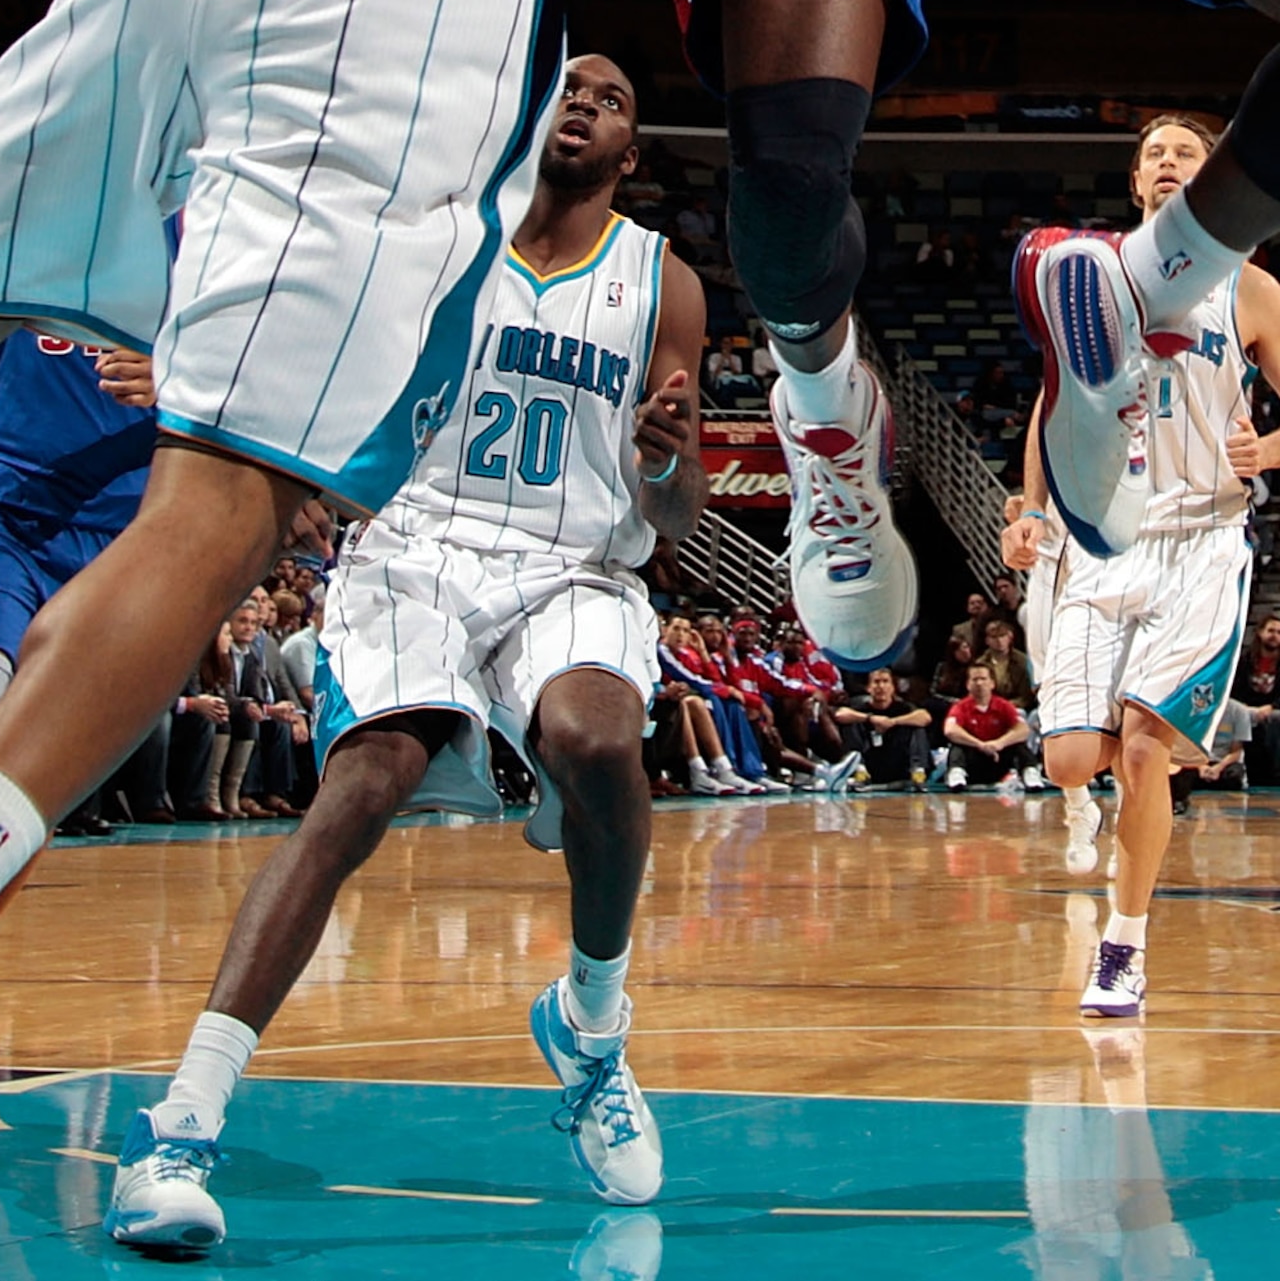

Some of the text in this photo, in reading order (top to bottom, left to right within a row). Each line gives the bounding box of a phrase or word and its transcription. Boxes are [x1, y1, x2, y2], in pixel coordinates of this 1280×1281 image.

[494, 325, 631, 410] ORLEANS
[464, 390, 569, 487] 20
[703, 421, 774, 434] EMERGENC
[727, 433, 757, 444] EXIT
